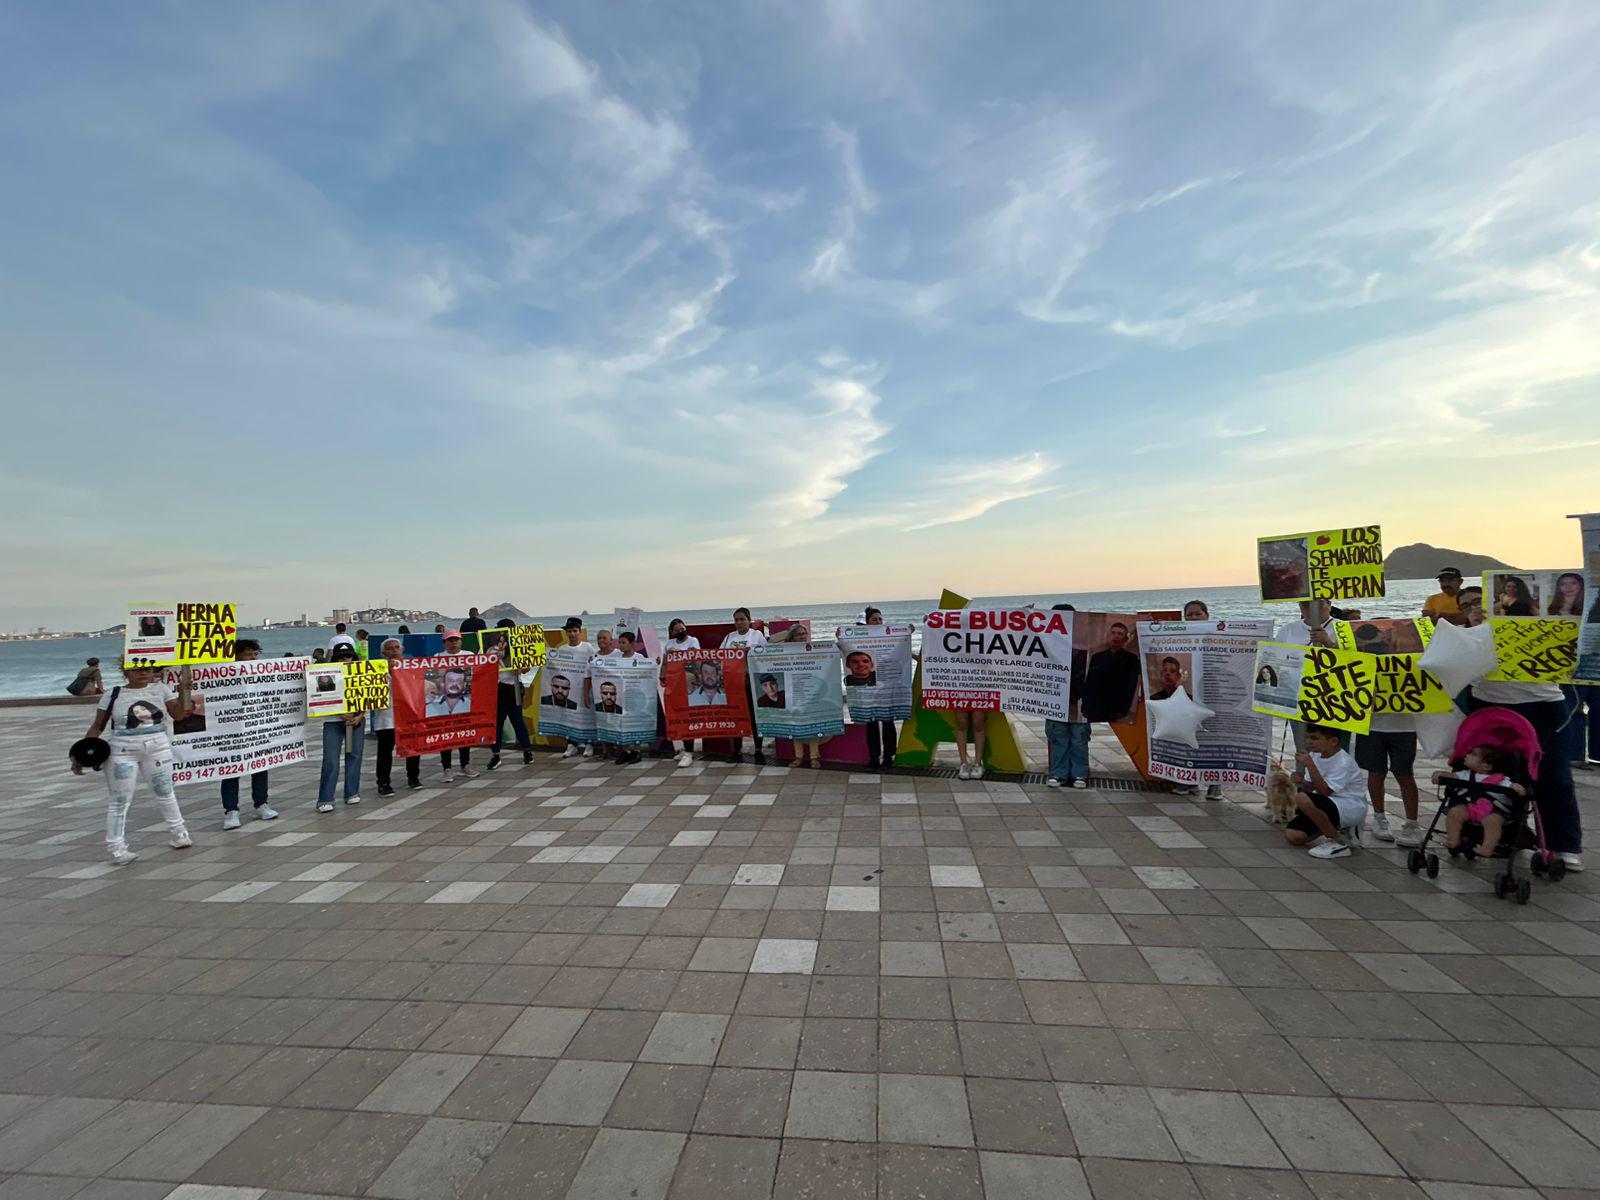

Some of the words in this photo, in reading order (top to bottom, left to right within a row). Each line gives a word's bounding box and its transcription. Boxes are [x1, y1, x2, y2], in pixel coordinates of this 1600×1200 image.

[1342, 526, 1380, 545] LOS
[1310, 544, 1382, 567] SEMAFOROS
[1308, 567, 1329, 579] TE
[1311, 572, 1385, 600] ESPERAN
[177, 603, 234, 622] HERMA
[178, 622, 225, 638] NITA
[928, 611, 961, 629] SE
[969, 611, 1068, 634] BUSCA
[1495, 619, 1555, 651] ristina
[513, 645, 536, 657] TUS
[943, 632, 1048, 658] CHAVA
[392, 655, 498, 670] DESAPARECIDO
[667, 650, 744, 662] DESAPARECIDO
[1304, 648, 1337, 673] YO
[1517, 636, 1578, 678] REGR
[344, 661, 376, 676] TIA
[950, 658, 993, 666] SALVADOR
[1035, 662, 1069, 672] GUERRA
[167, 665, 237, 684] AYDANOS
[240, 665, 248, 676] A
[200, 678, 242, 690] SALVADOR
[243, 674, 276, 684] VELARDE
[277, 672, 304, 682] GUERRA
[1374, 669, 1443, 693] LTAN
[206, 692, 248, 703] DESAPARECIÓ
[257, 690, 275, 698] LOMAS
[285, 686, 306, 694] MAZATLA
[1373, 690, 1425, 712] DOS
[224, 707, 245, 716] NOCHE
[257, 704, 272, 712] LUNES
[926, 700, 950, 709] (669)
[952, 700, 968, 708] 147
[1002, 704, 1036, 714] ESTRAÑA
[1037, 708, 1066, 719] MUCHO!
[1022, 698, 1049, 709] FAMILIA
[1298, 687, 1374, 723] BUSCO
[218, 710, 264, 724] DESCONOCIENDO
[268, 730, 282, 738] SOLO
[688, 722, 704, 730] 667
[172, 736, 212, 746] CUALQUIER
[214, 730, 257, 741] INFORMACIÓN
[426, 735, 440, 744] 667
[441, 732, 455, 740] 157
[456, 730, 476, 738] 1930
[172, 762, 183, 770] TU
[185, 757, 229, 769] AUSENCIA
[230, 755, 242, 763] ES
[243, 752, 252, 760] UN
[254, 747, 280, 758] INFINITO
[282, 740, 304, 752] DOLOR
[172, 770, 192, 783] 669
[195, 768, 214, 778] 147
[218, 764, 244, 776] 8224
[250, 759, 266, 770] 669
[268, 753, 284, 763] 933
[286, 748, 306, 762] 4610
[1151, 763, 1164, 775] 669
[1165, 766, 1176, 778] 147
[1176, 769, 1197, 782] 8224
[1204, 770, 1220, 782] 669
[1222, 771, 1240, 783] 933
[1242, 772, 1266, 788] 4610
